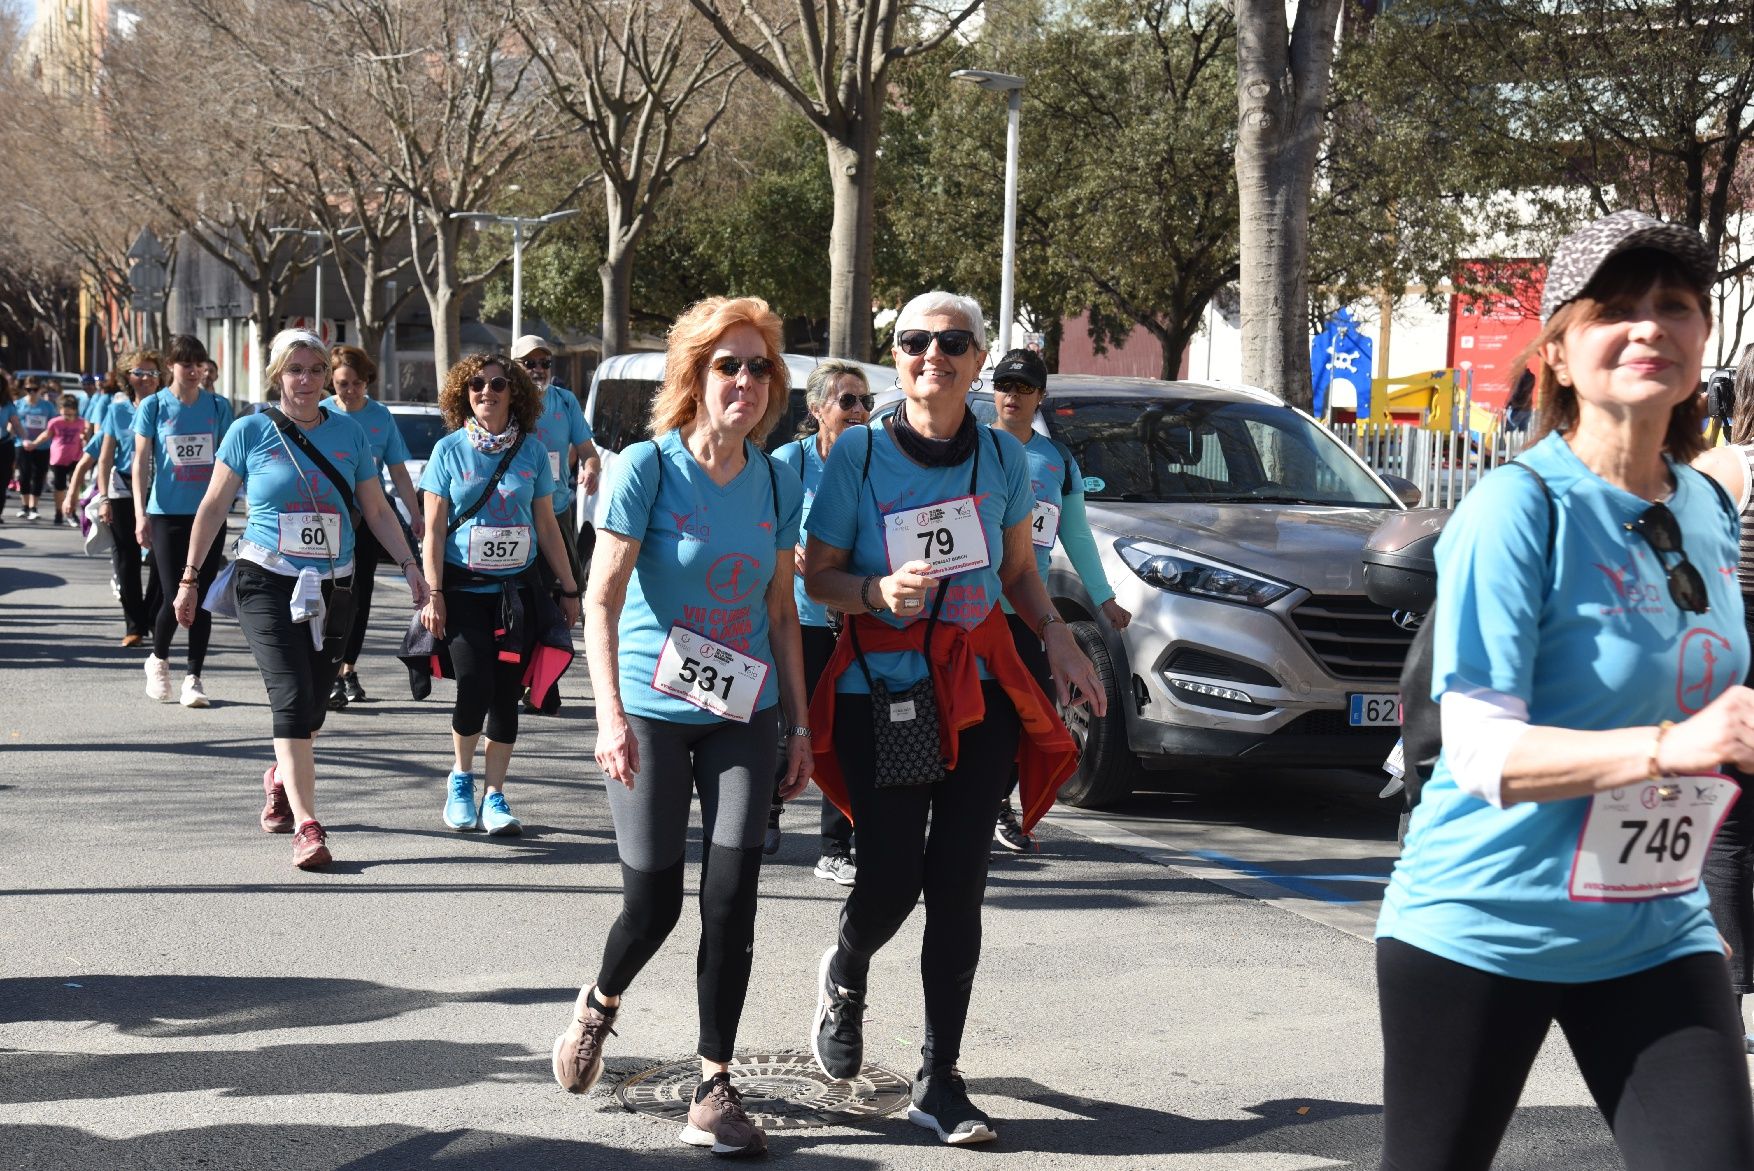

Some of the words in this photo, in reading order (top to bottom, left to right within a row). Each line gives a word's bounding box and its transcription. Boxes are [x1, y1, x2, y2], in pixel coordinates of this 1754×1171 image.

[176, 444, 203, 457] 287
[301, 527, 326, 545] 60
[917, 527, 954, 559] 79
[483, 541, 519, 558] 357
[678, 656, 735, 701] 531
[1367, 699, 1400, 722] 62
[1618, 815, 1694, 864] 746
